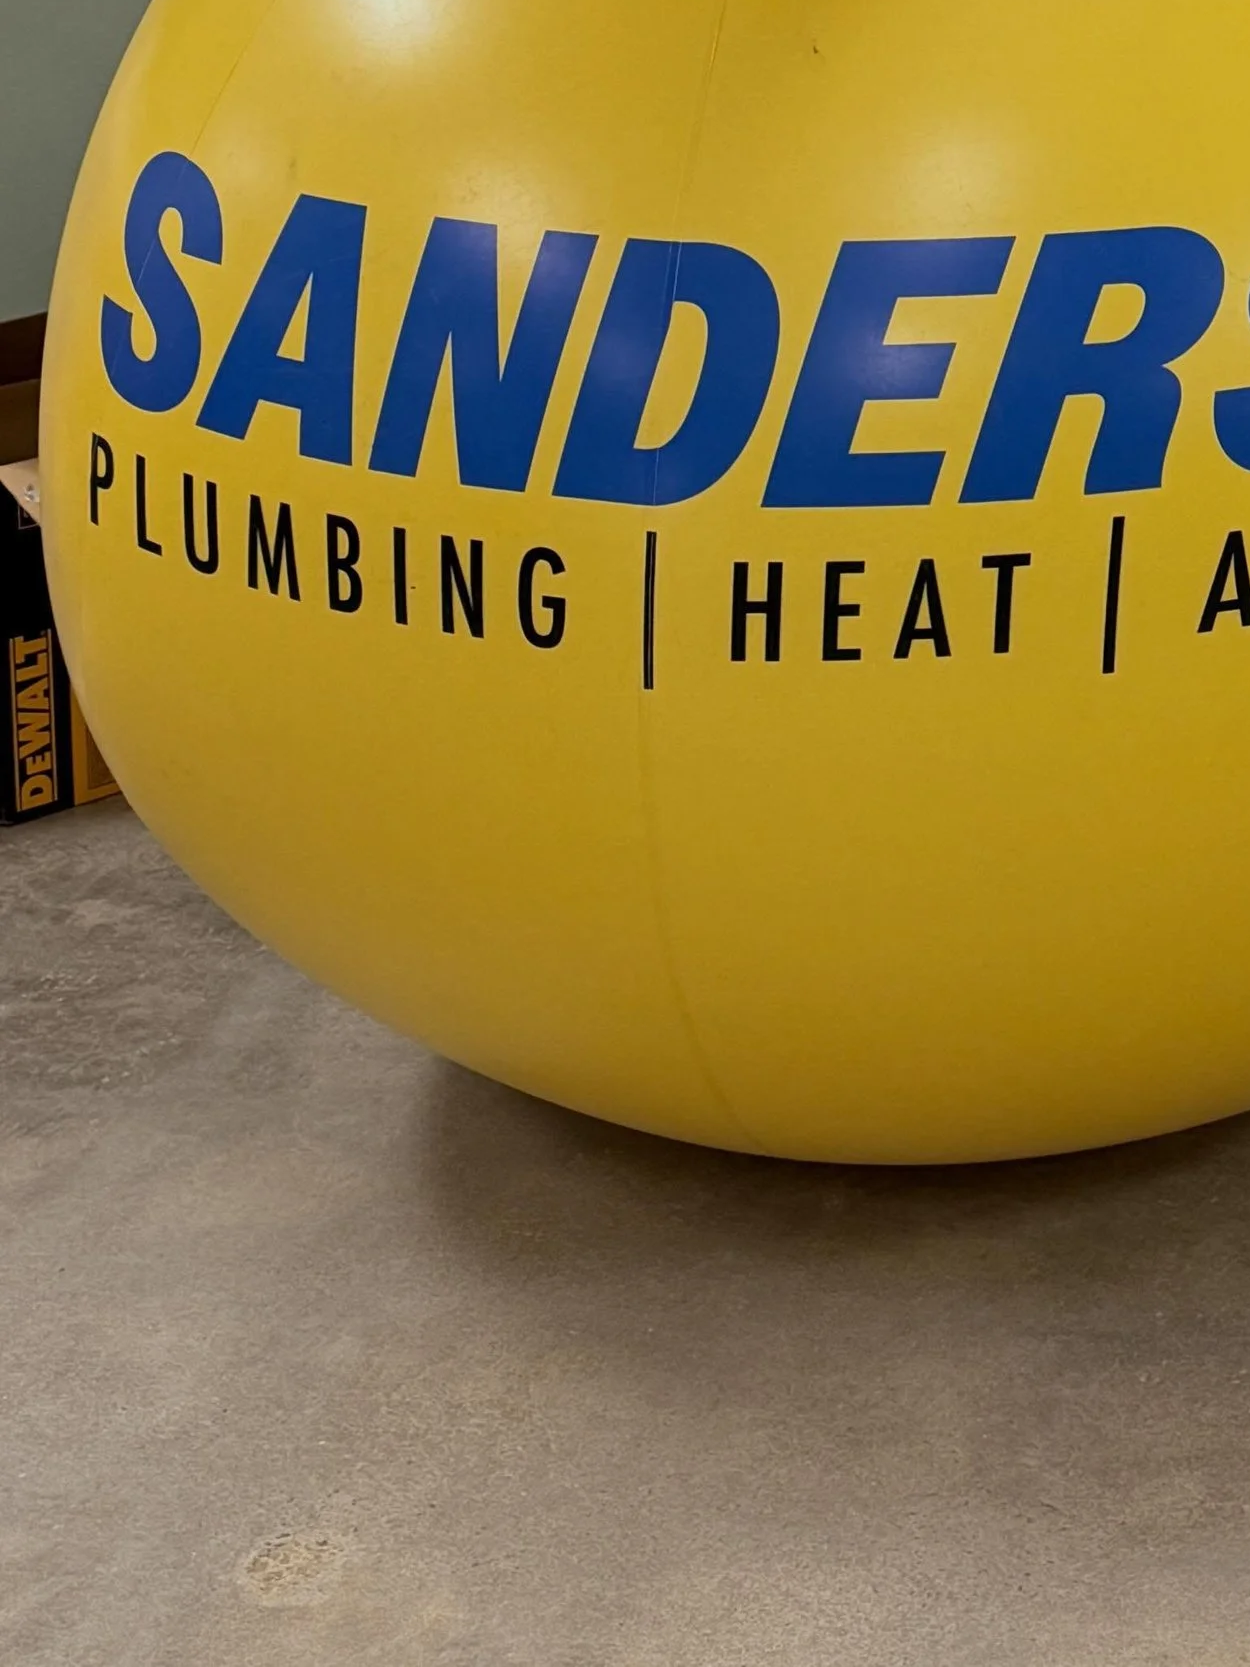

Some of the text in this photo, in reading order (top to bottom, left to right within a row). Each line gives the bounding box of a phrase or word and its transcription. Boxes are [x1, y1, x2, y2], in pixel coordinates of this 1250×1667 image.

[89, 432, 567, 649] PLUMBING
[730, 552, 1032, 662] HEAT
[14, 635, 54, 811] DEWALT
